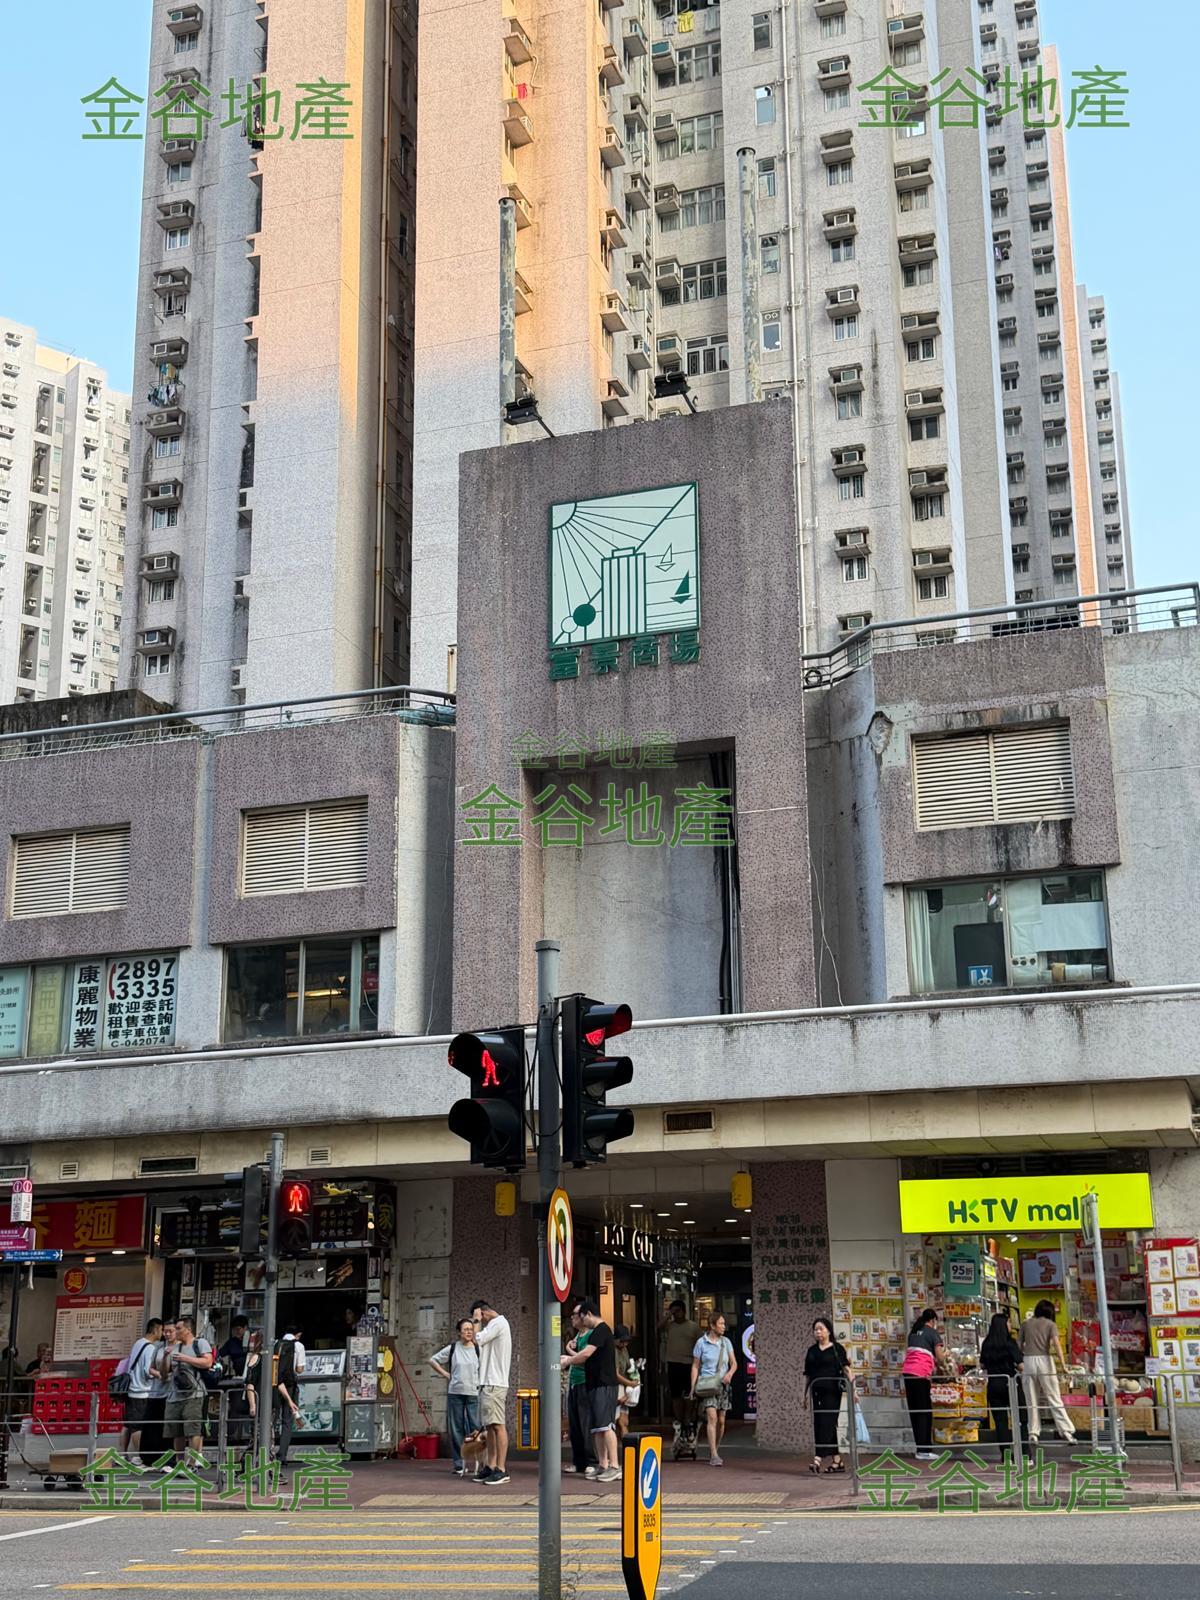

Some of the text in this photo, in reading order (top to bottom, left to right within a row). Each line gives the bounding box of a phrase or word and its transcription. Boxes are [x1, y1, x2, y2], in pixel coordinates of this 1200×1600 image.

[550, 632, 700, 681] 富景商場
[117, 957, 176, 981] 2897
[116, 978, 175, 1001] 3335
[74, 964, 100, 1048] 康麗物業
[107, 998, 174, 1015] 歡迎委託
[107, 1012, 173, 1029] 租售查詢
[111, 1036, 166, 1048] C-042074
[948, 1196, 1081, 1224] HKTV mal
[761, 1254, 819, 1267] FULLVIEW
[766, 1270, 816, 1282] GARDEN
